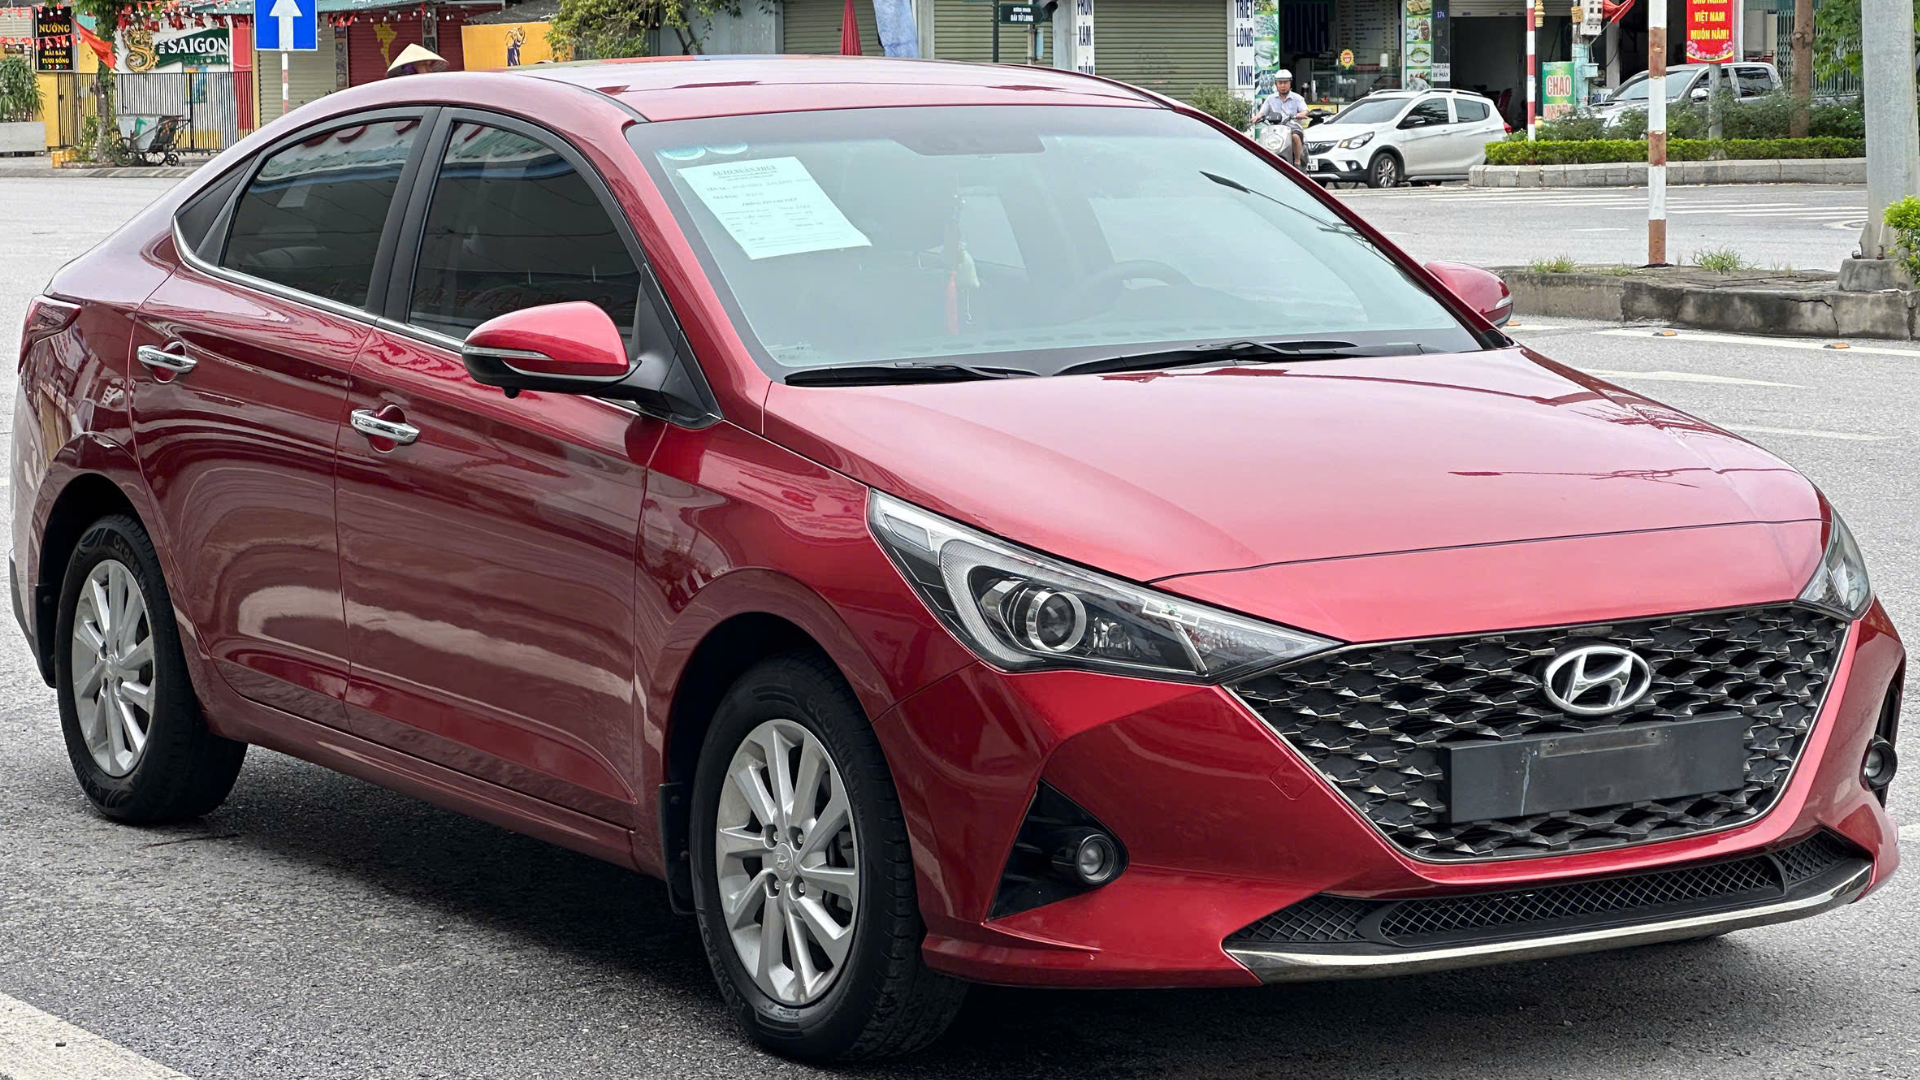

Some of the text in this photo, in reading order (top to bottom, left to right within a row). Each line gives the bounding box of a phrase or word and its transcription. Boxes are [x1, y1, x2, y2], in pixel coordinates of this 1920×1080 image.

[1694, 9, 1725, 24] VIỆT NAM
[39, 22, 70, 33] NƯỚNG
[1236, 23, 1253, 47] LÔNG
[167, 37, 229, 54] SAIGON
[1546, 72, 1571, 97] CHÁO
